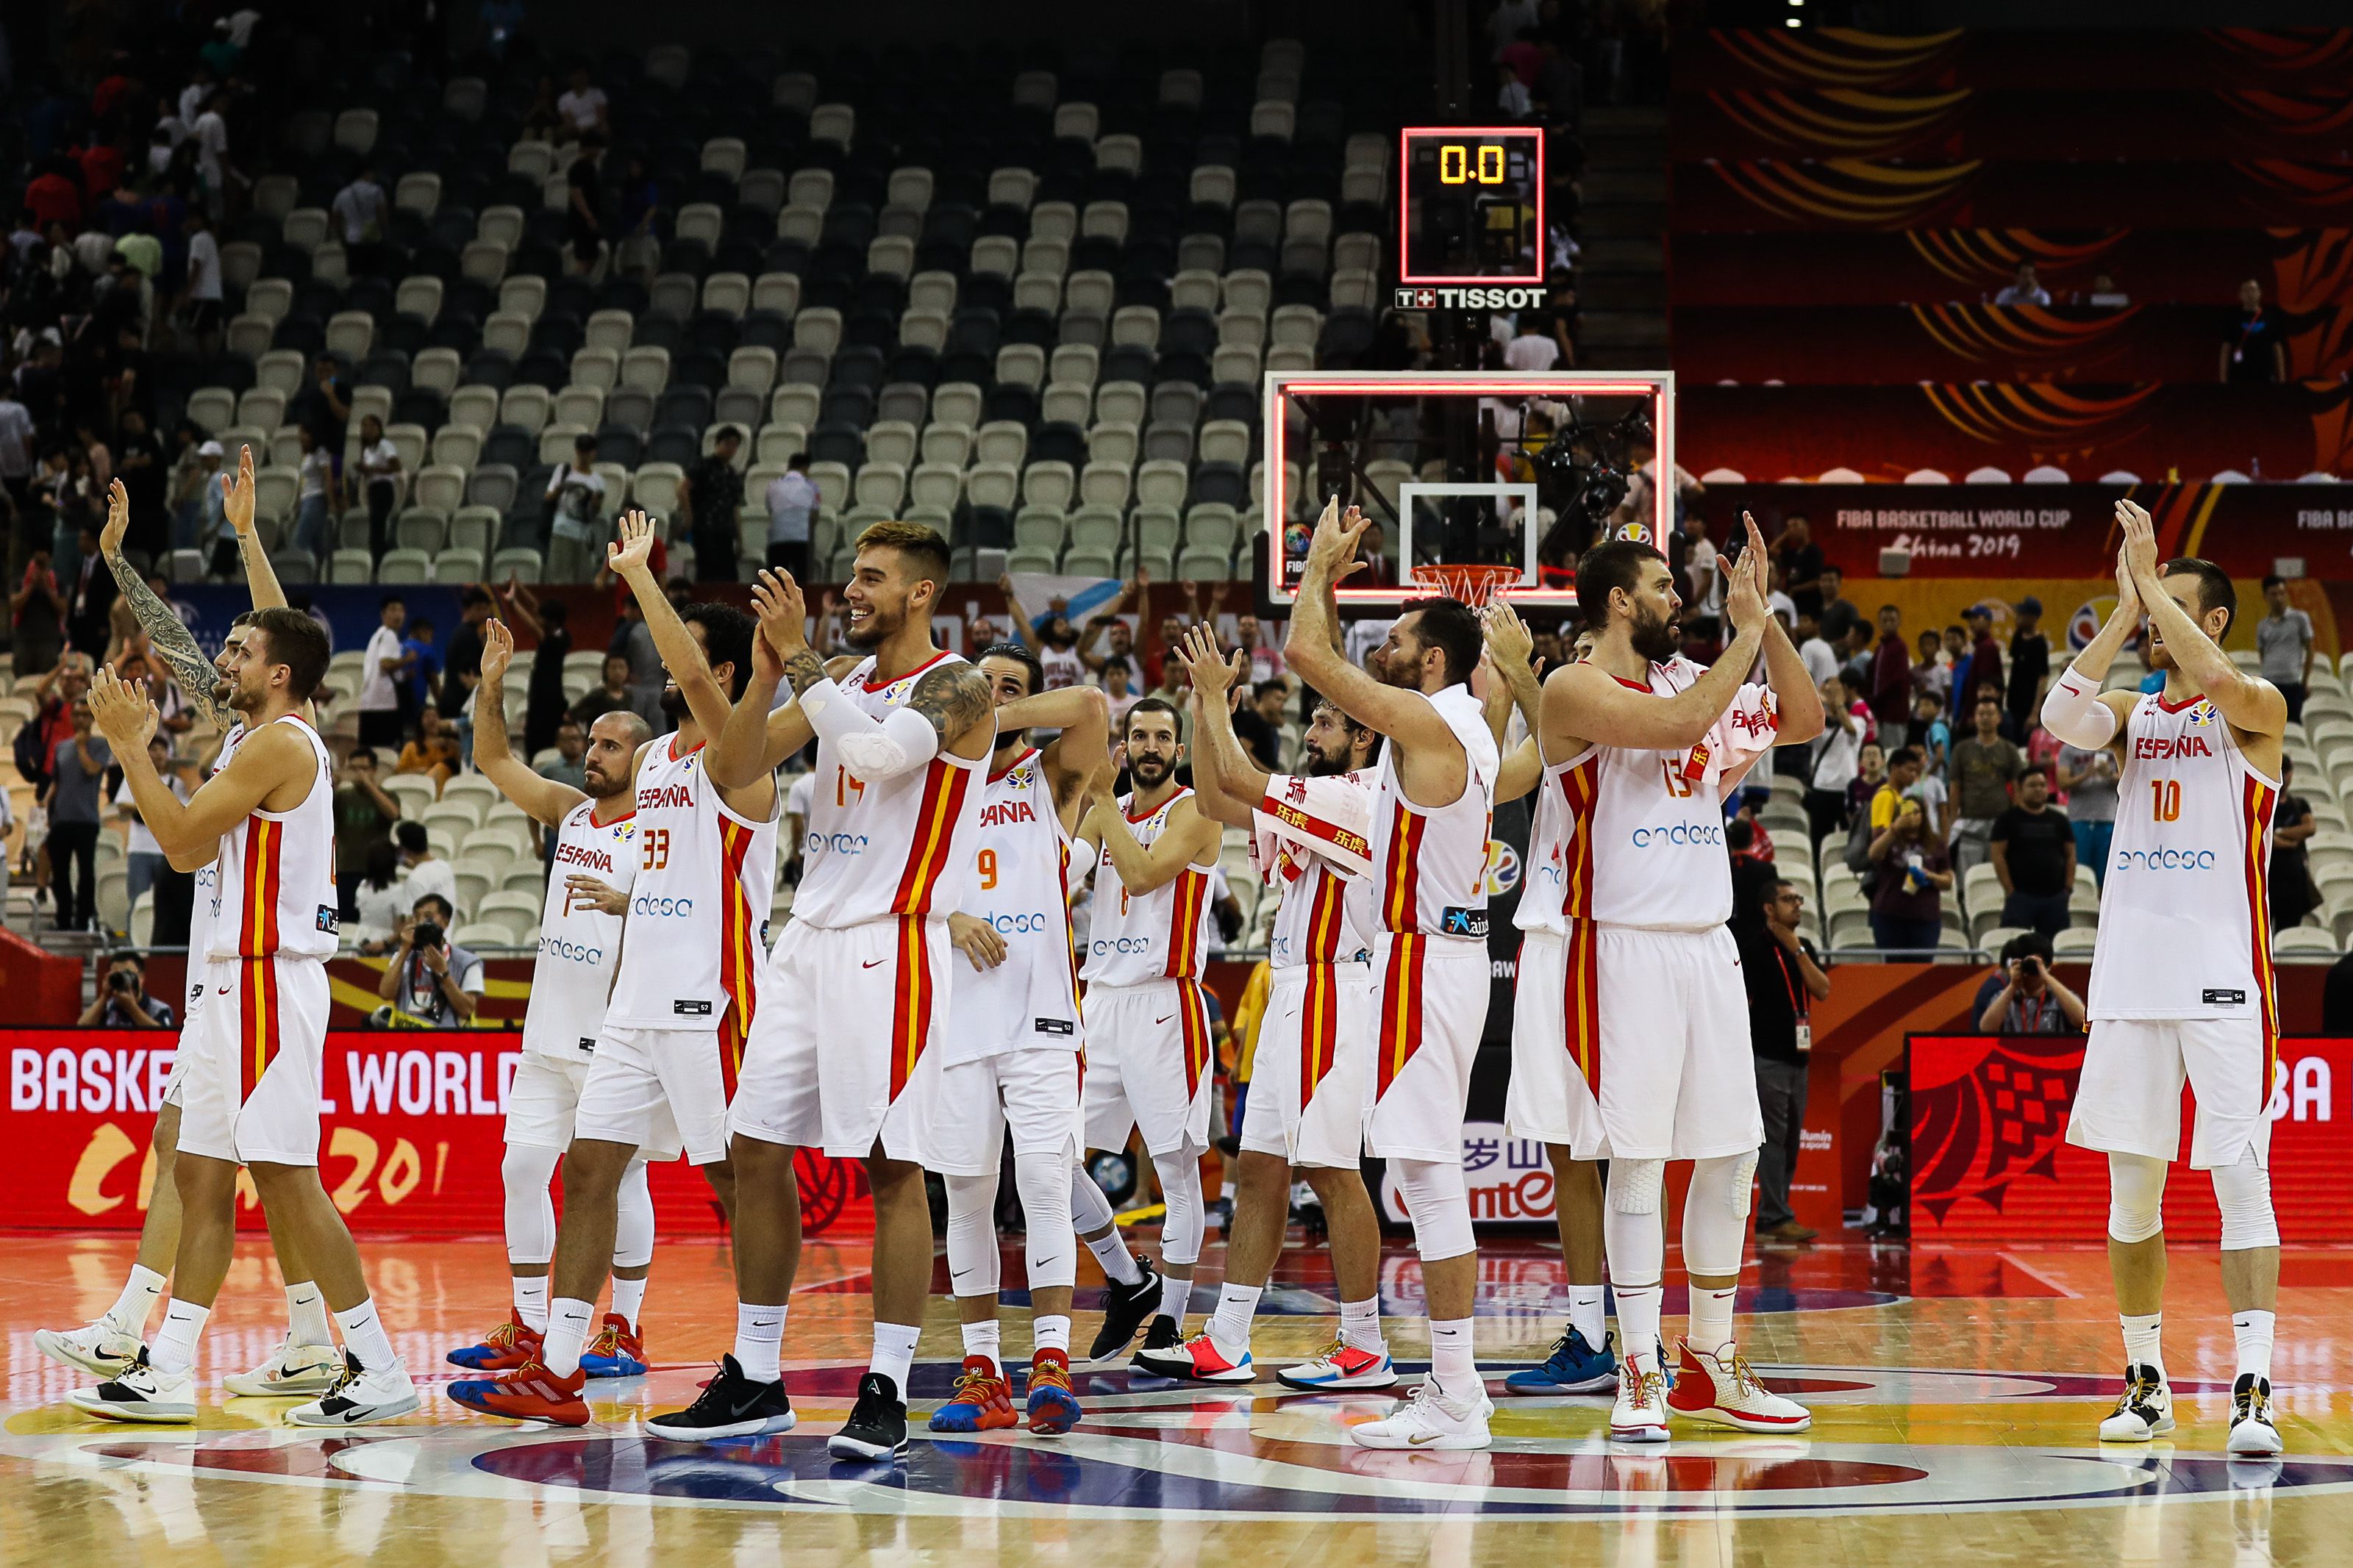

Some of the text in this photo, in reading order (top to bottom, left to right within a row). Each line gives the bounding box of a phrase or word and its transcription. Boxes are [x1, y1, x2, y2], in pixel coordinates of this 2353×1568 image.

[1440, 146, 1504, 184] 0.0
[1438, 288, 1547, 308] TISSOT
[1837, 509, 2071, 528] FIBA BASKETBALL WORLD CUP
[2297, 510, 2333, 528] FIBA
[1967, 533, 2021, 559] 2019
[2135, 735, 2213, 759] ESPAÑA
[637, 784, 694, 809] ESPAÑA
[2151, 779, 2181, 822] 10
[555, 842, 614, 874] ESPAÑA
[643, 828, 671, 870] 33
[2117, 844, 2215, 871] endesa
[977, 848, 998, 890] 9
[630, 892, 693, 917] desa
[1463, 1139, 1543, 1173] 岁山
